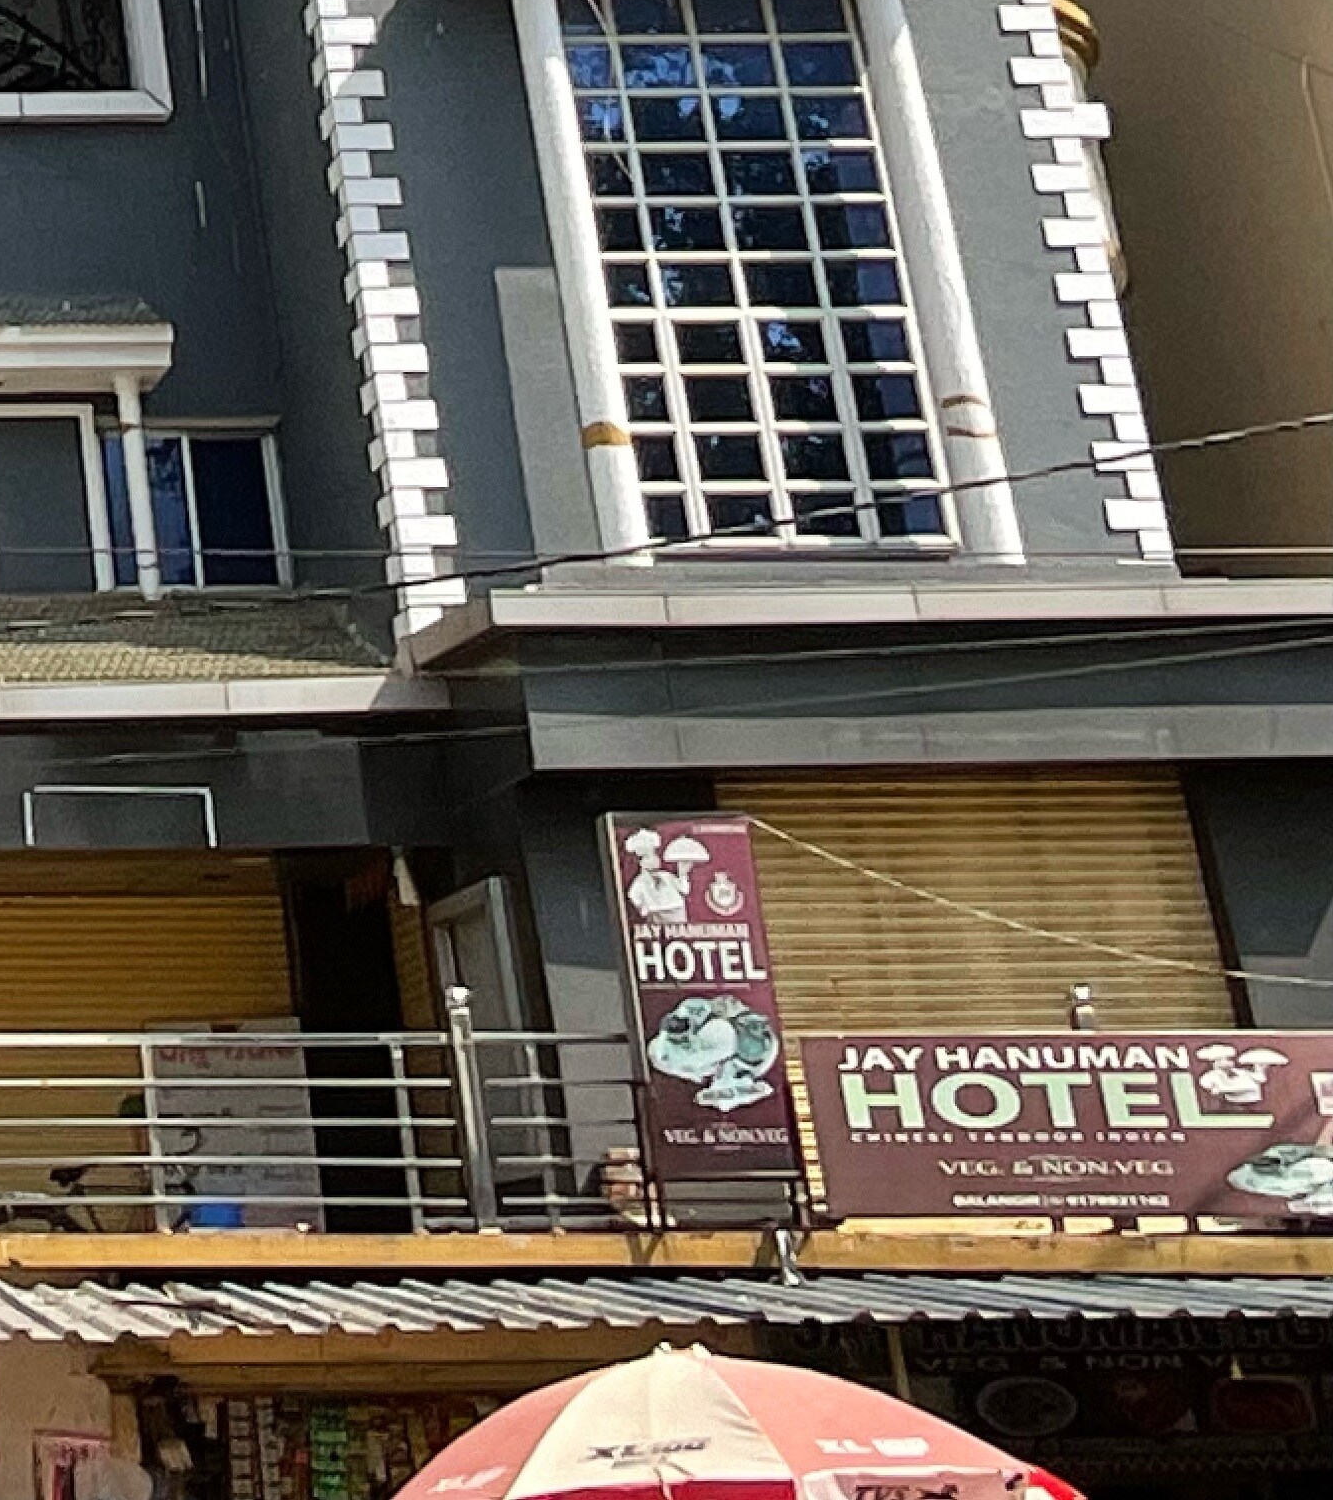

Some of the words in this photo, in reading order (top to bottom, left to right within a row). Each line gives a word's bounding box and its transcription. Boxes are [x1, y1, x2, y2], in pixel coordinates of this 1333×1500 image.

[634, 940, 768, 981] HOTEL
[838, 1047, 923, 1069] JAY
[936, 1046, 1190, 1069] HANUMAN
[841, 1072, 1276, 1130] HOTEL
